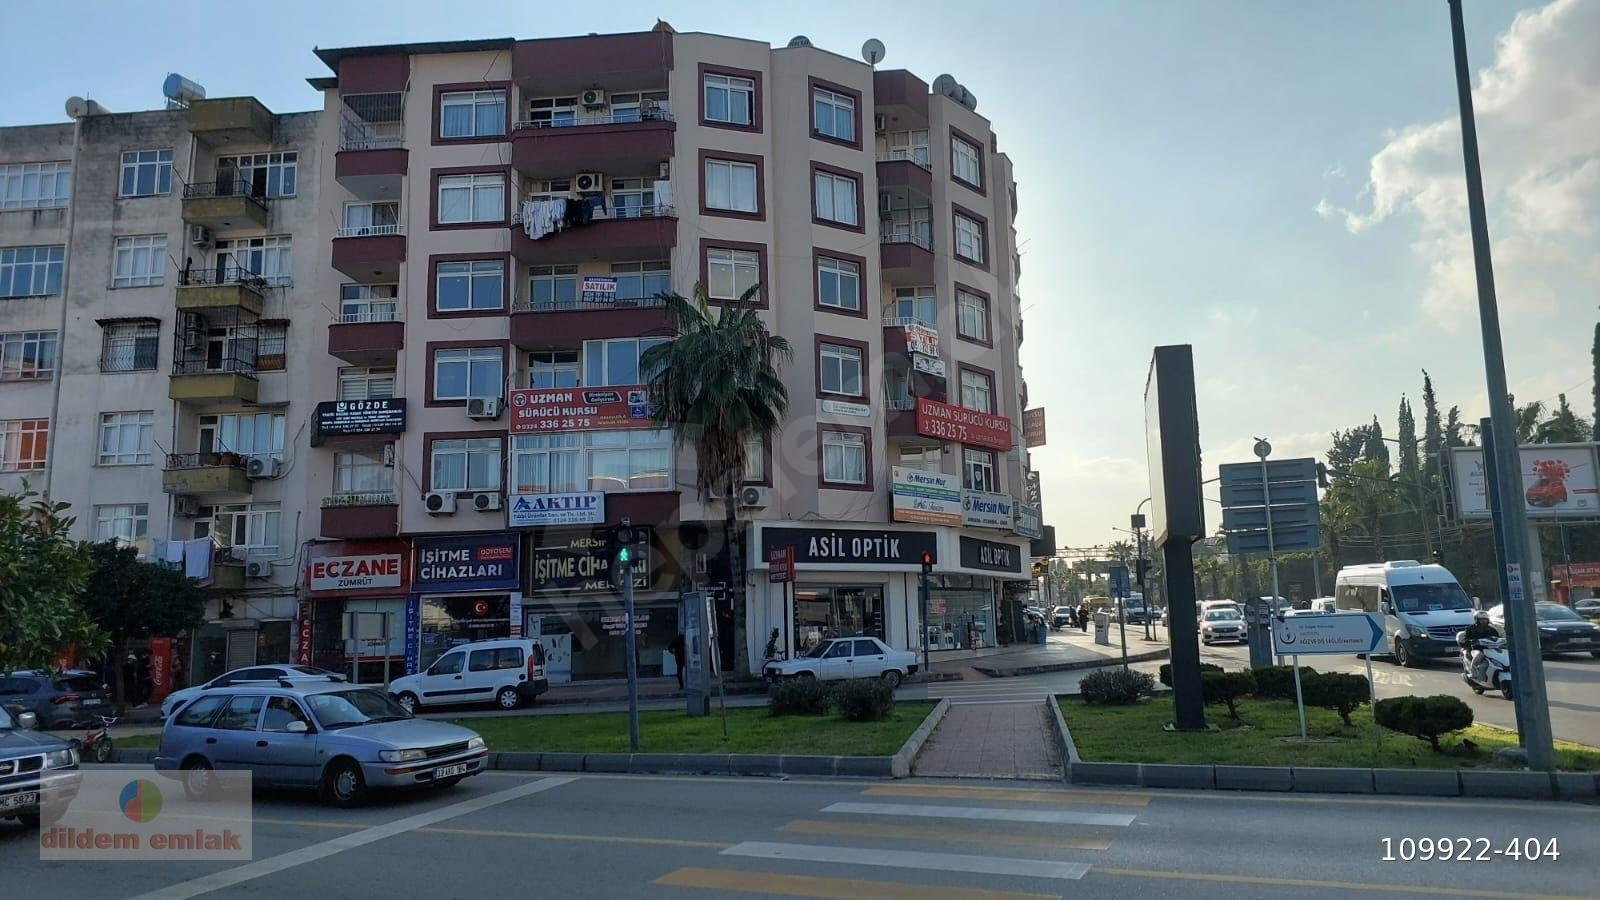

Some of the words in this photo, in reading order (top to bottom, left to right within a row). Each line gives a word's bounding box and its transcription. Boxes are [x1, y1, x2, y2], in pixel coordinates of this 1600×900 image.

[585, 282, 615, 291] SATILIK
[350, 401, 388, 410] GÖZDE
[530, 393, 573, 404] UZMAN
[518, 407, 560, 418] SÜRÜCÜ
[562, 406, 598, 416] KURSU
[922, 403, 951, 419] UZMAN
[953, 408, 983, 426] SÜRÜCÜ
[985, 417, 1009, 432] KURSU
[540, 420, 559, 429] 336
[562, 419, 575, 428] 25
[578, 418, 590, 427] 75
[931, 419, 946, 436] 336
[947, 422, 957, 438] 25
[958, 425, 968, 440] 75
[914, 474, 935, 484] Mersin
[935, 477, 946, 487] Nur
[972, 499, 997, 513] Mersin
[998, 502, 1010, 515] Nur
[809, 532, 845, 557] ASİL
[852, 534, 900, 558] OPTİK
[421, 548, 470, 564] İŞİTME
[313, 559, 398, 578] ECZANE
[421, 564, 502, 579] CİHAZLARI
[535, 553, 575, 584] İŞİTME
[338, 577, 372, 587] ZÜMRÜT
